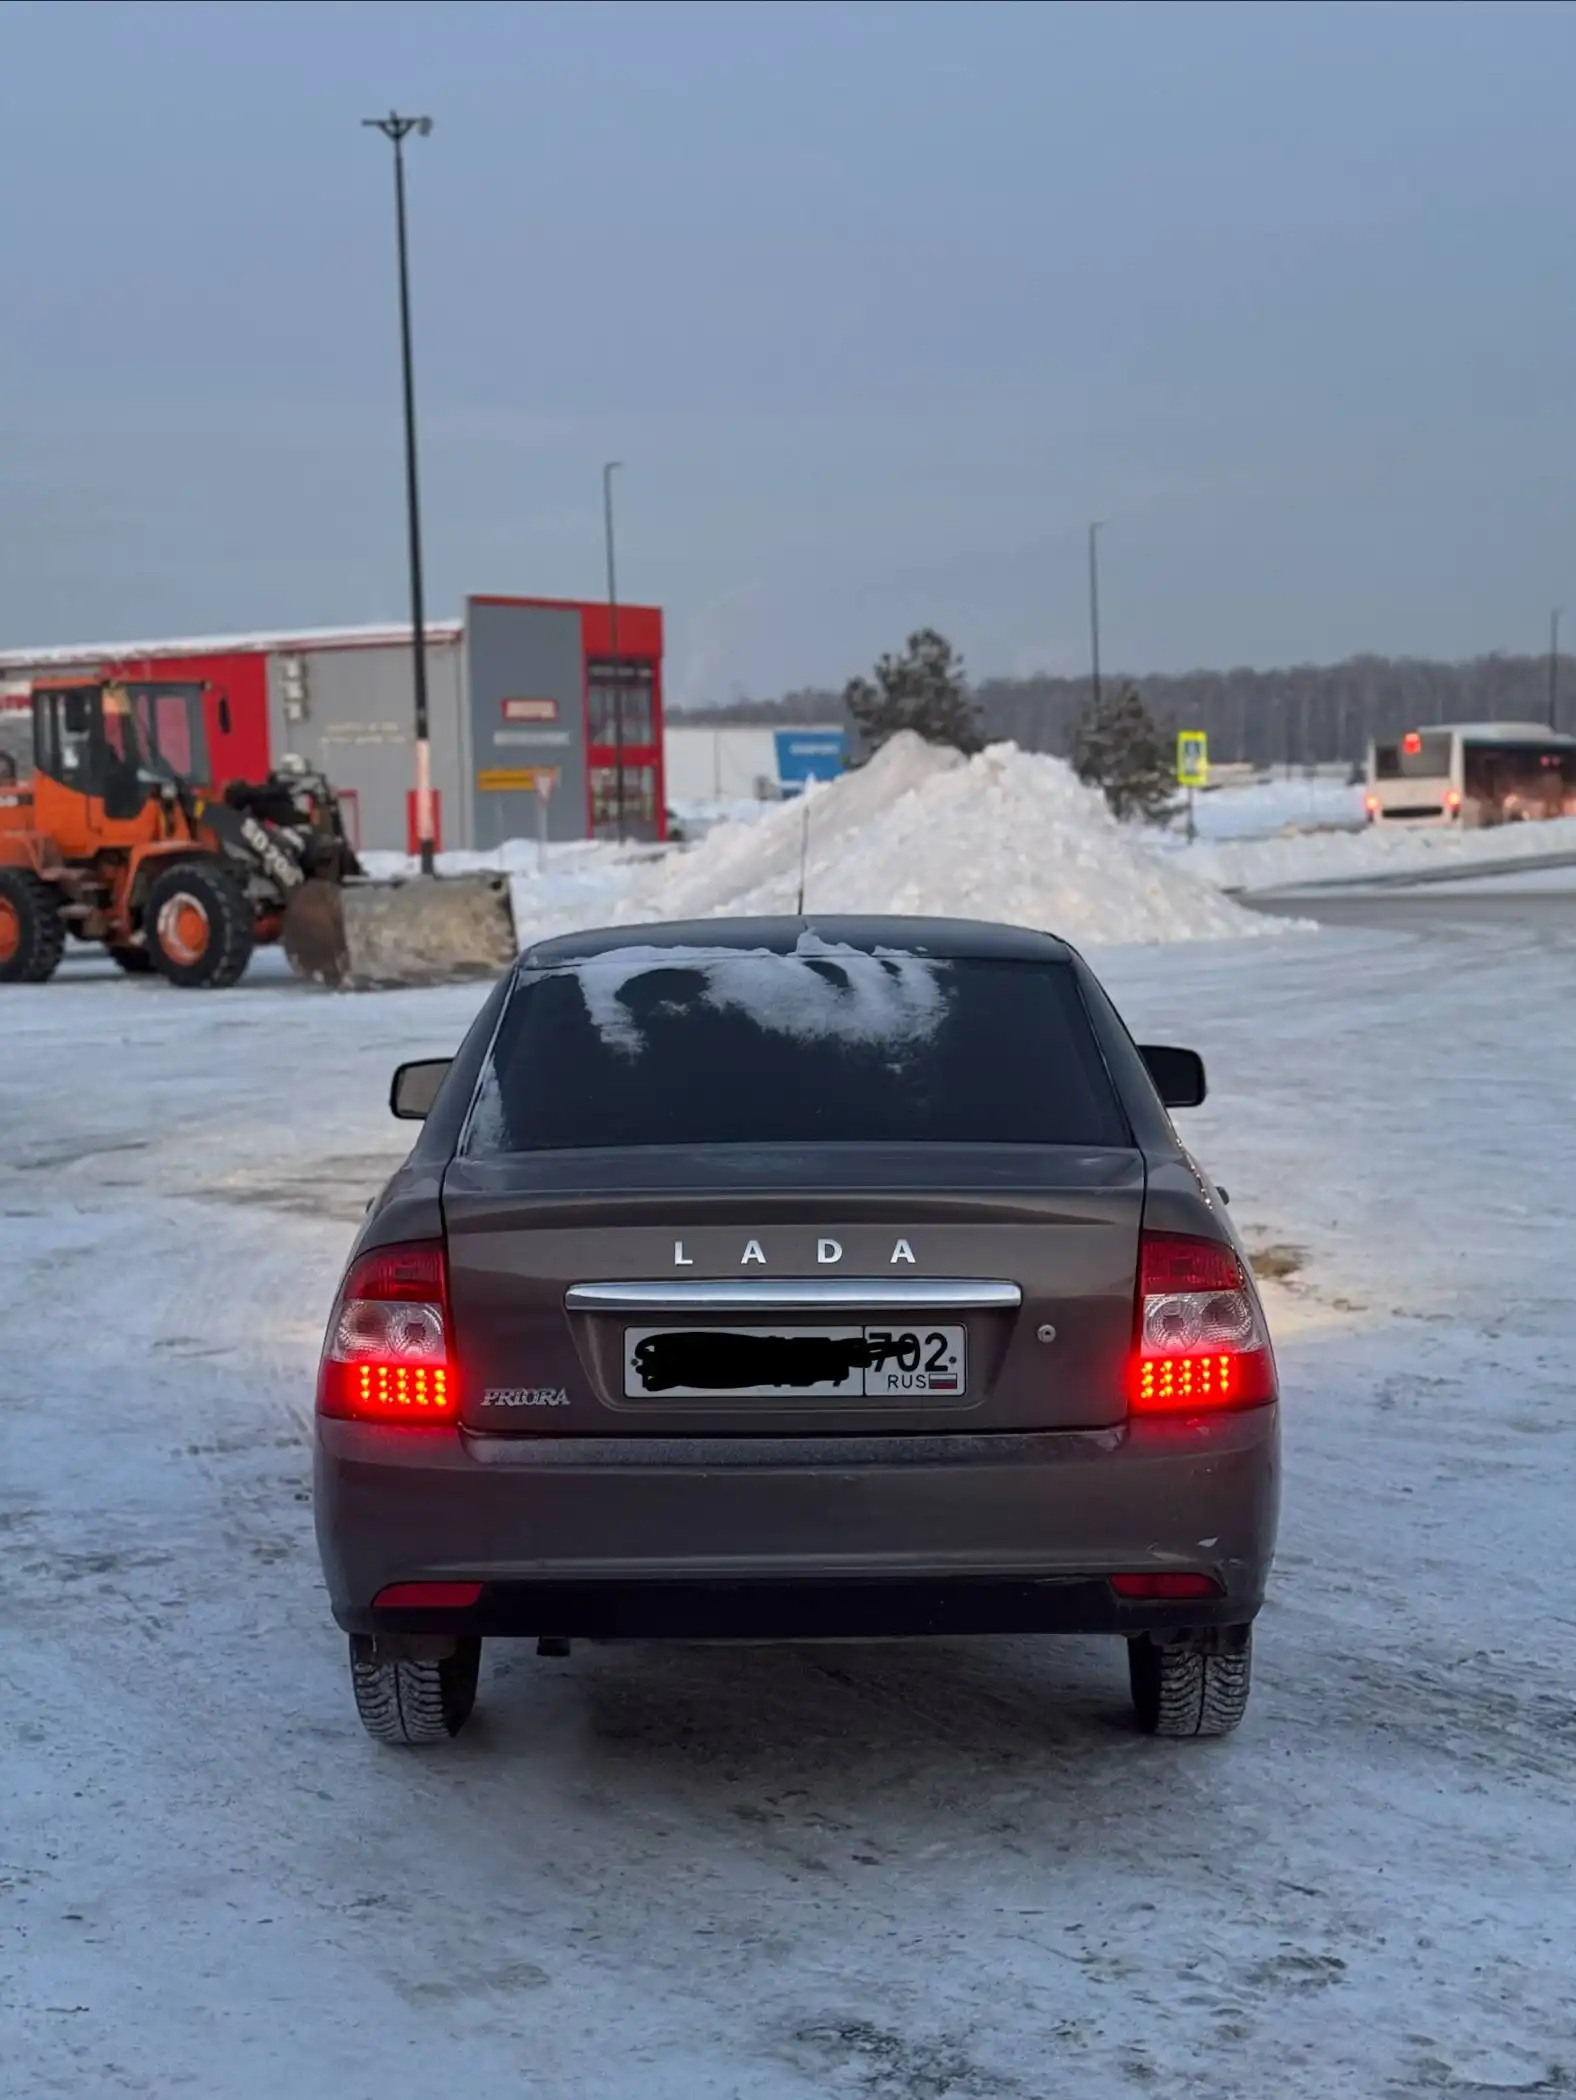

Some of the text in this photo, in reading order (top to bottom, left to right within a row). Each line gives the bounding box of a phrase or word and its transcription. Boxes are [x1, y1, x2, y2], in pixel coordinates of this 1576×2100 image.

[674, 1239, 916, 1265] LADA
[869, 1332, 948, 1372] 702
[887, 1374, 926, 1389] RUS
[480, 1387, 571, 1406] PRIORA
